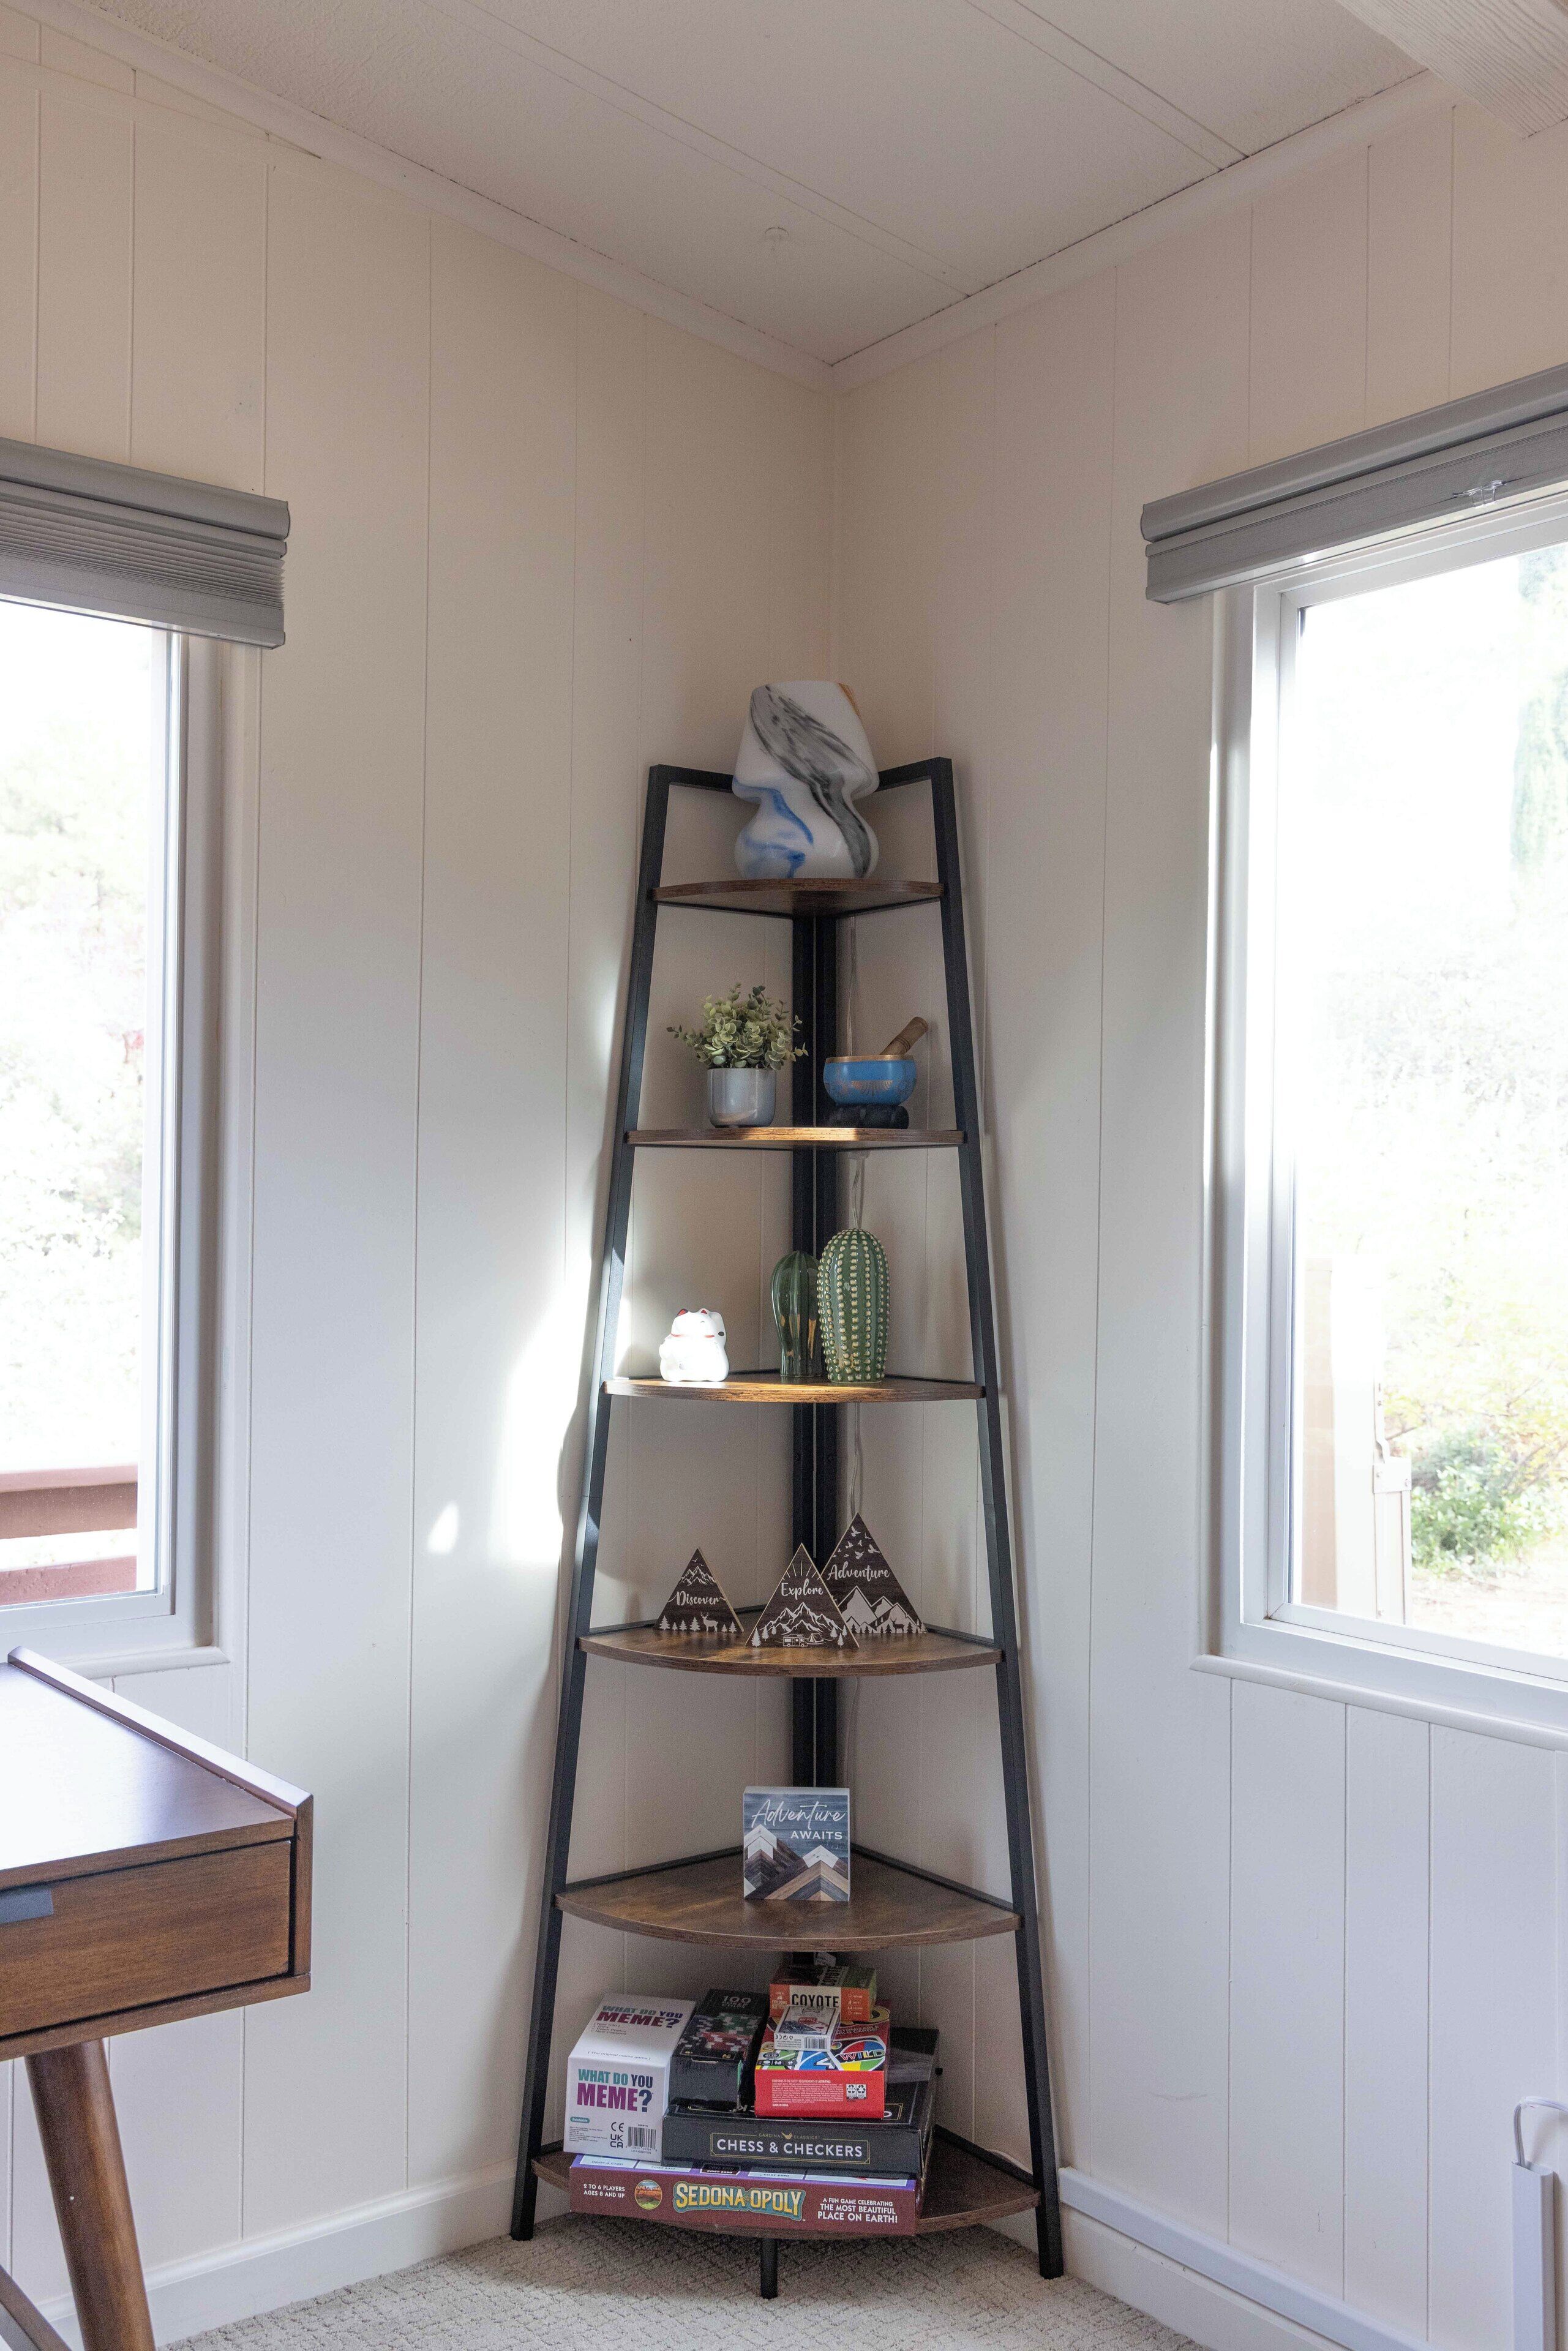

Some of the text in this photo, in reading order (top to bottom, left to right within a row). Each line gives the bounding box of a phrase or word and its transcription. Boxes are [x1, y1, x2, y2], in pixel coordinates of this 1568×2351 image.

[827, 1561, 890, 1581] Adventure
[781, 1578, 823, 1600] Explore
[669, 1590, 726, 1606] Discover
[751, 1799, 846, 1831] Adventure
[790, 1831, 842, 1840] AWAITS
[792, 1993, 839, 2007] COYOTE
[596, 2011, 680, 2028] MEME?
[840, 2049, 885, 2061] WILD
[578, 2069, 653, 2088] WHAT DO YOU
[577, 2082, 653, 2112] MEME?
[611, 2122, 625, 2132] CE
[716, 2139, 863, 2158] CHESS & CHECKERS
[817, 2211, 898, 2223] PLACE ON EARTH!
[858, 2206, 896, 2214] BEAUTIFUL
